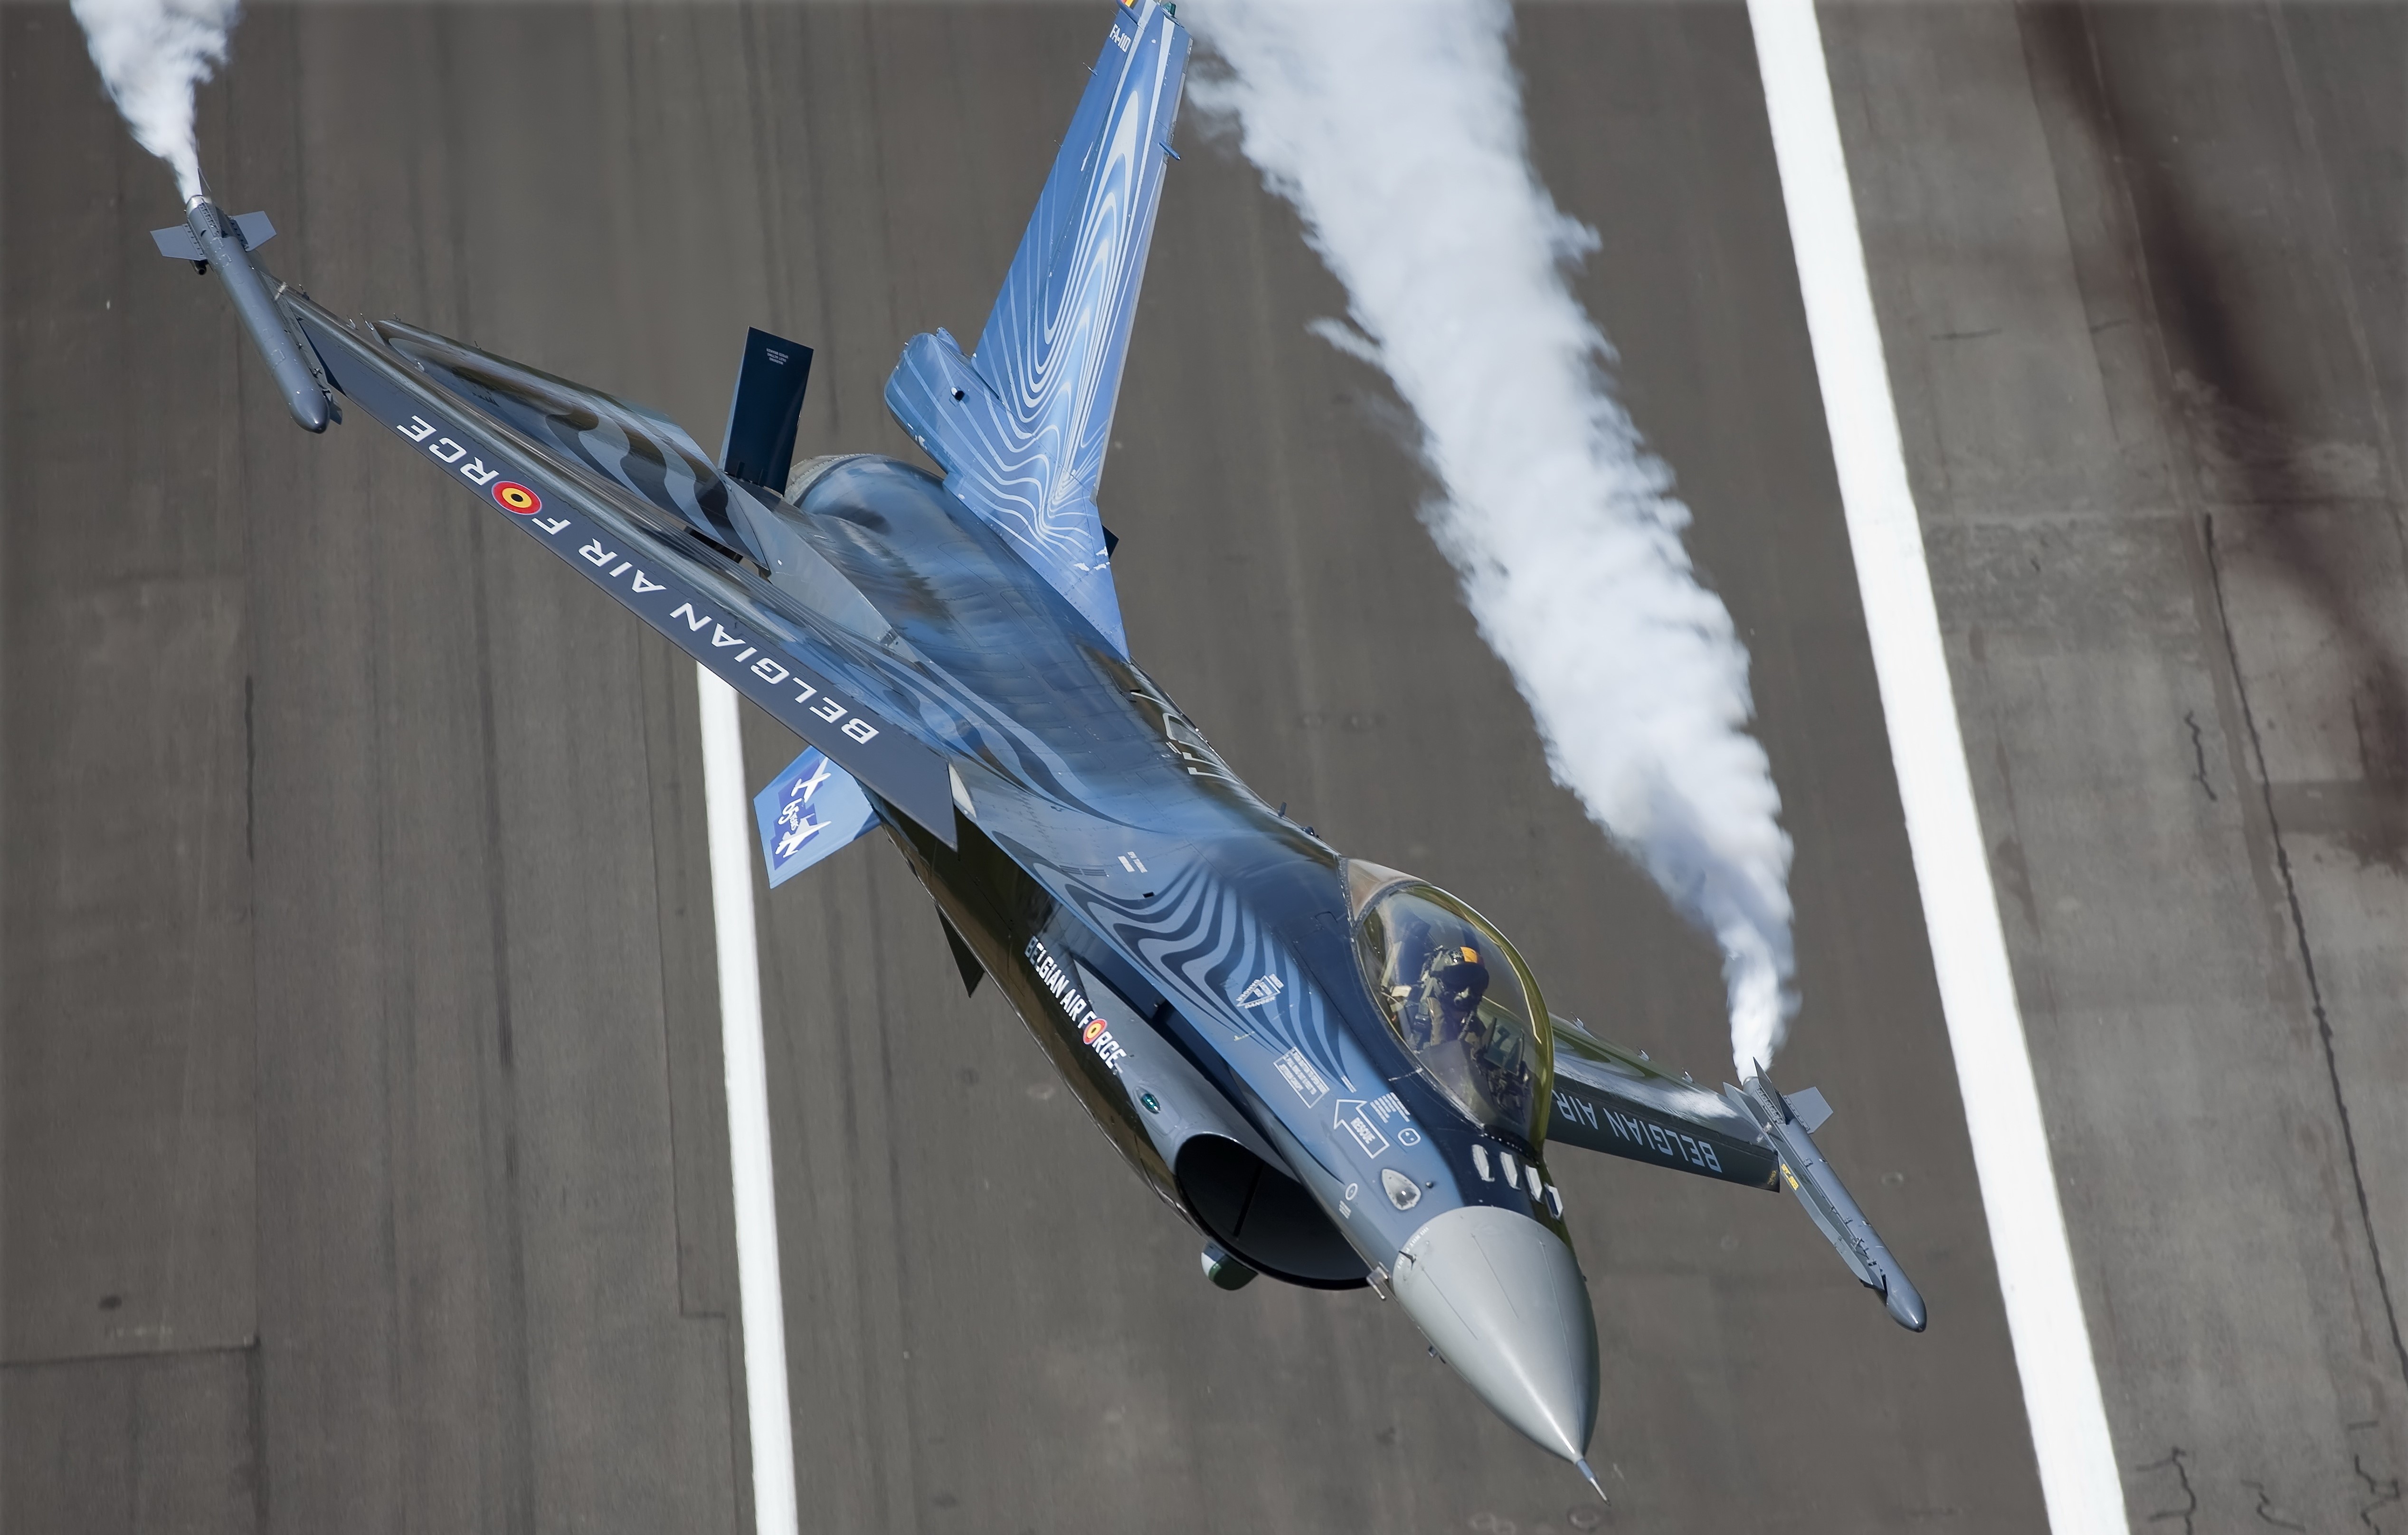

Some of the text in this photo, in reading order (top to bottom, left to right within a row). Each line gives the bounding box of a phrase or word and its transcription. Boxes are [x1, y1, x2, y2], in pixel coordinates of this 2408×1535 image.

[1109, 24, 1131, 53] FA-110
[578, 538, 666, 593] AIR
[670, 602, 879, 744] BELGIAN
[1024, 936, 1070, 998] BELGIAN
[1060, 988, 1087, 1021] AIR
[1350, 1117, 1375, 1144] RESCUE
[1552, 1089, 1722, 1173] BELGIAN AIR
